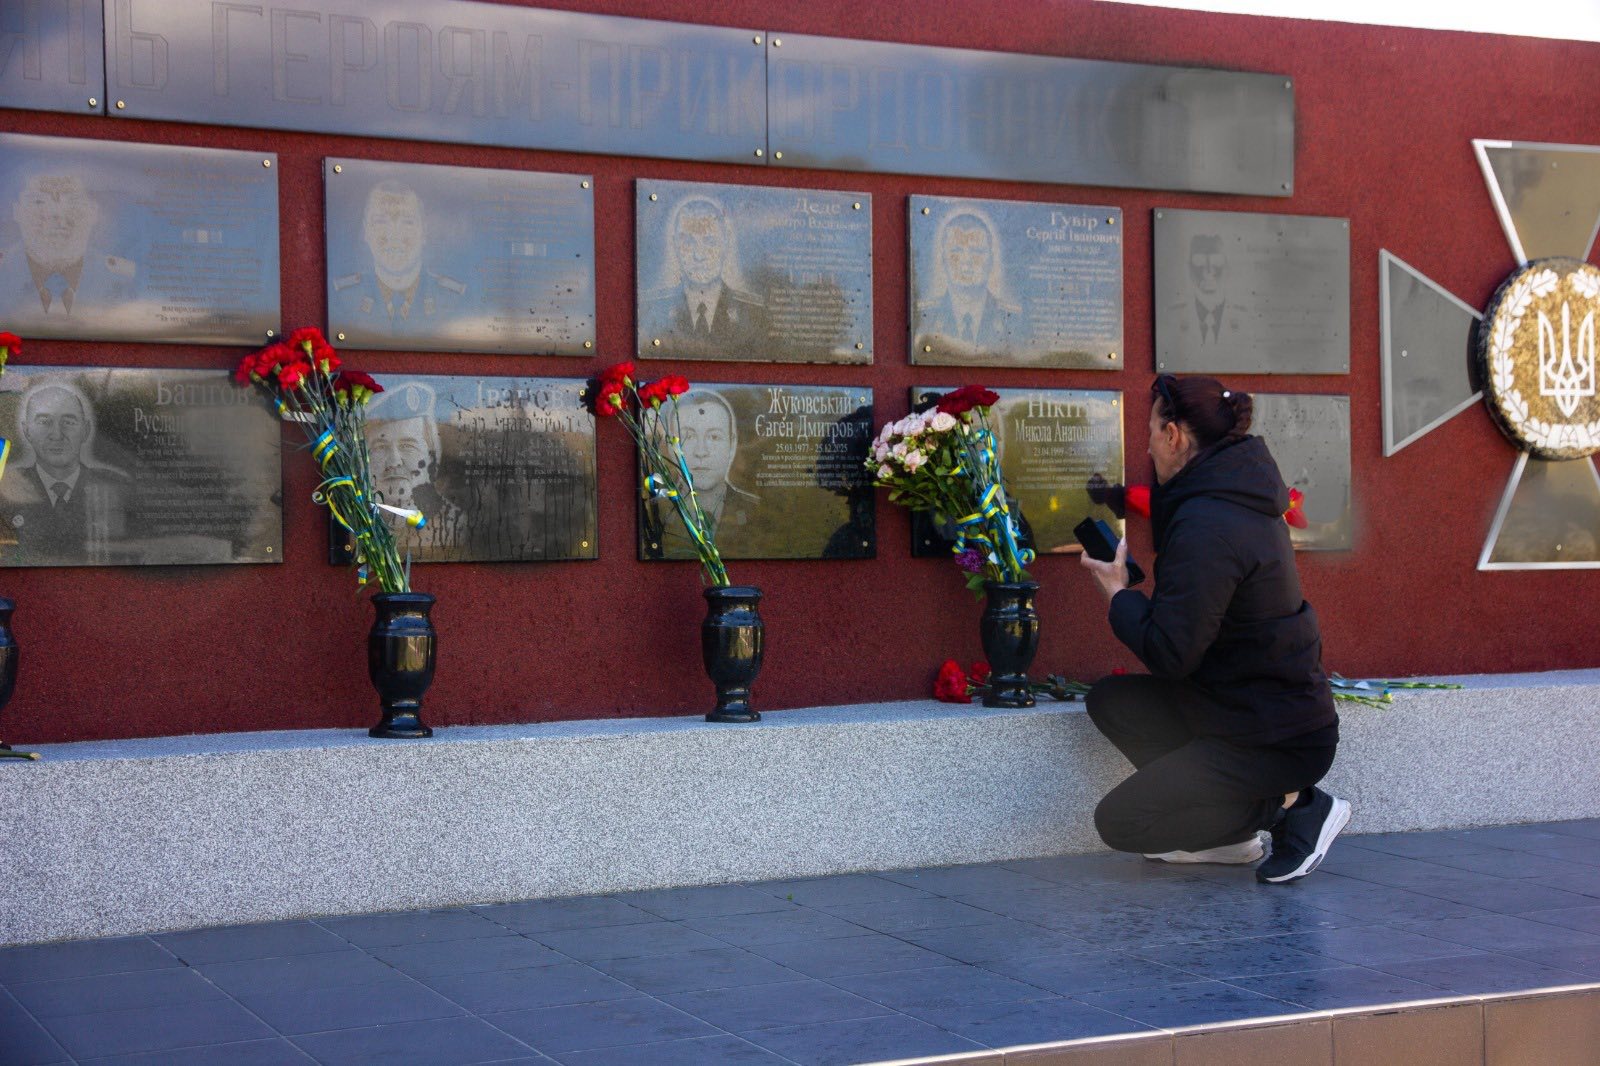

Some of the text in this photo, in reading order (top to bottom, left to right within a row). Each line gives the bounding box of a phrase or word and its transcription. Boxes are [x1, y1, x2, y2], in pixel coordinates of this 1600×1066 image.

[768, 388, 851, 421] Жуковський
[755, 415, 793, 438] Євген
[1015, 418, 1052, 442] Микола
